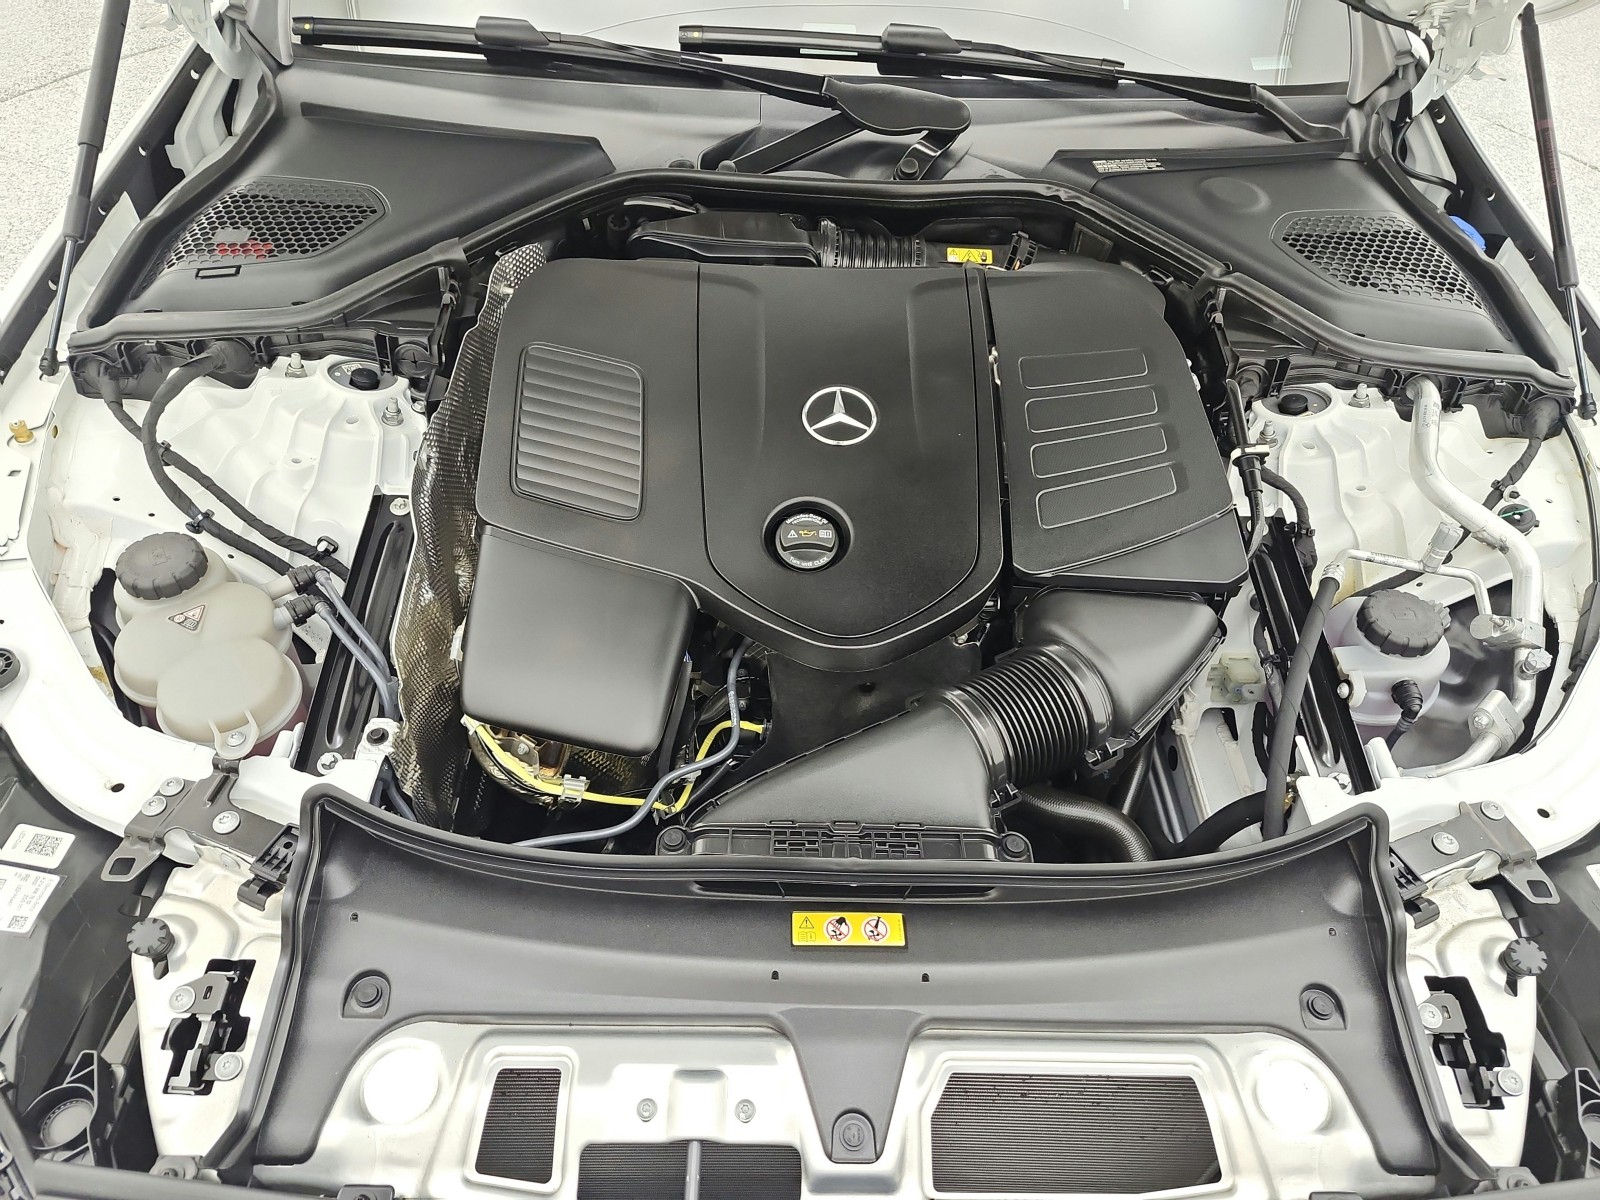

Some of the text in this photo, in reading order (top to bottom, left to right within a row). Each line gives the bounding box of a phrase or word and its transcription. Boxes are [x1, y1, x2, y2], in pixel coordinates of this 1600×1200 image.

[786, 514, 822, 524] Mercedes-Benz
[790, 556, 800, 564] Turn
[814, 556, 829, 565] CLICK
